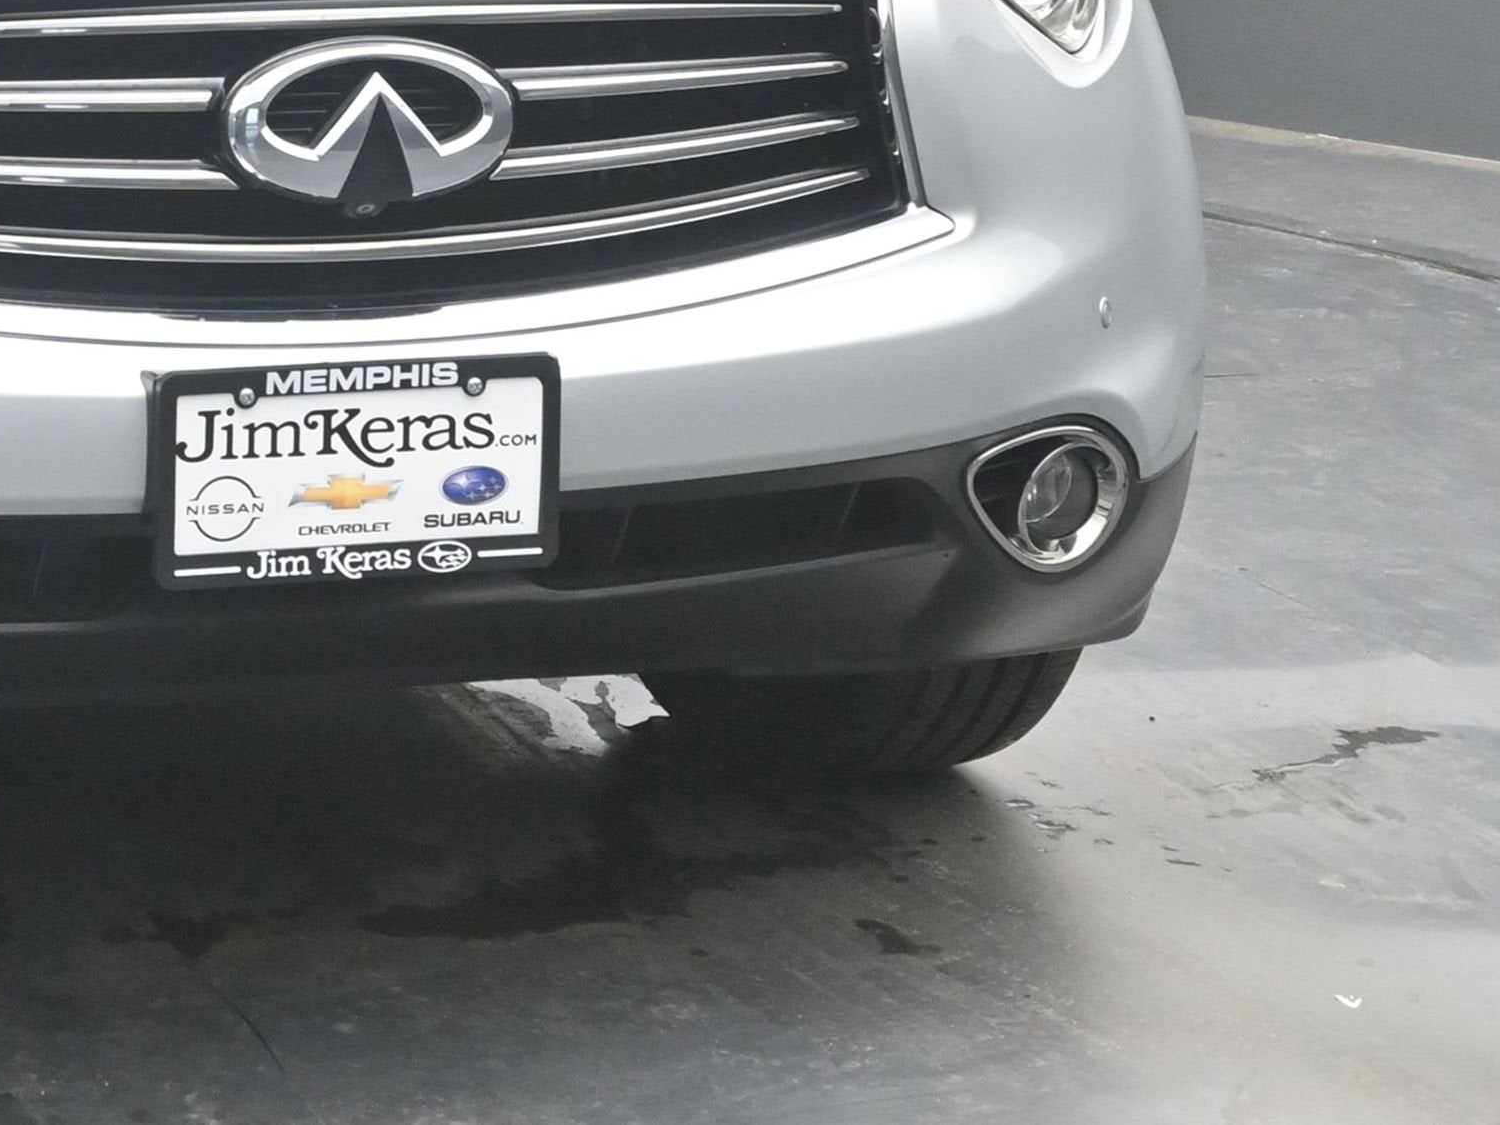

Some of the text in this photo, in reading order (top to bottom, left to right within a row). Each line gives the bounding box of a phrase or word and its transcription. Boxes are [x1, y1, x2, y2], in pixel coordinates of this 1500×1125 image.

[266, 362, 458, 395] MEMPHIS
[187, 502, 264, 516] NISSAN
[298, 521, 391, 536] CHEVROLET
[247, 546, 412, 579] Jim Keras
